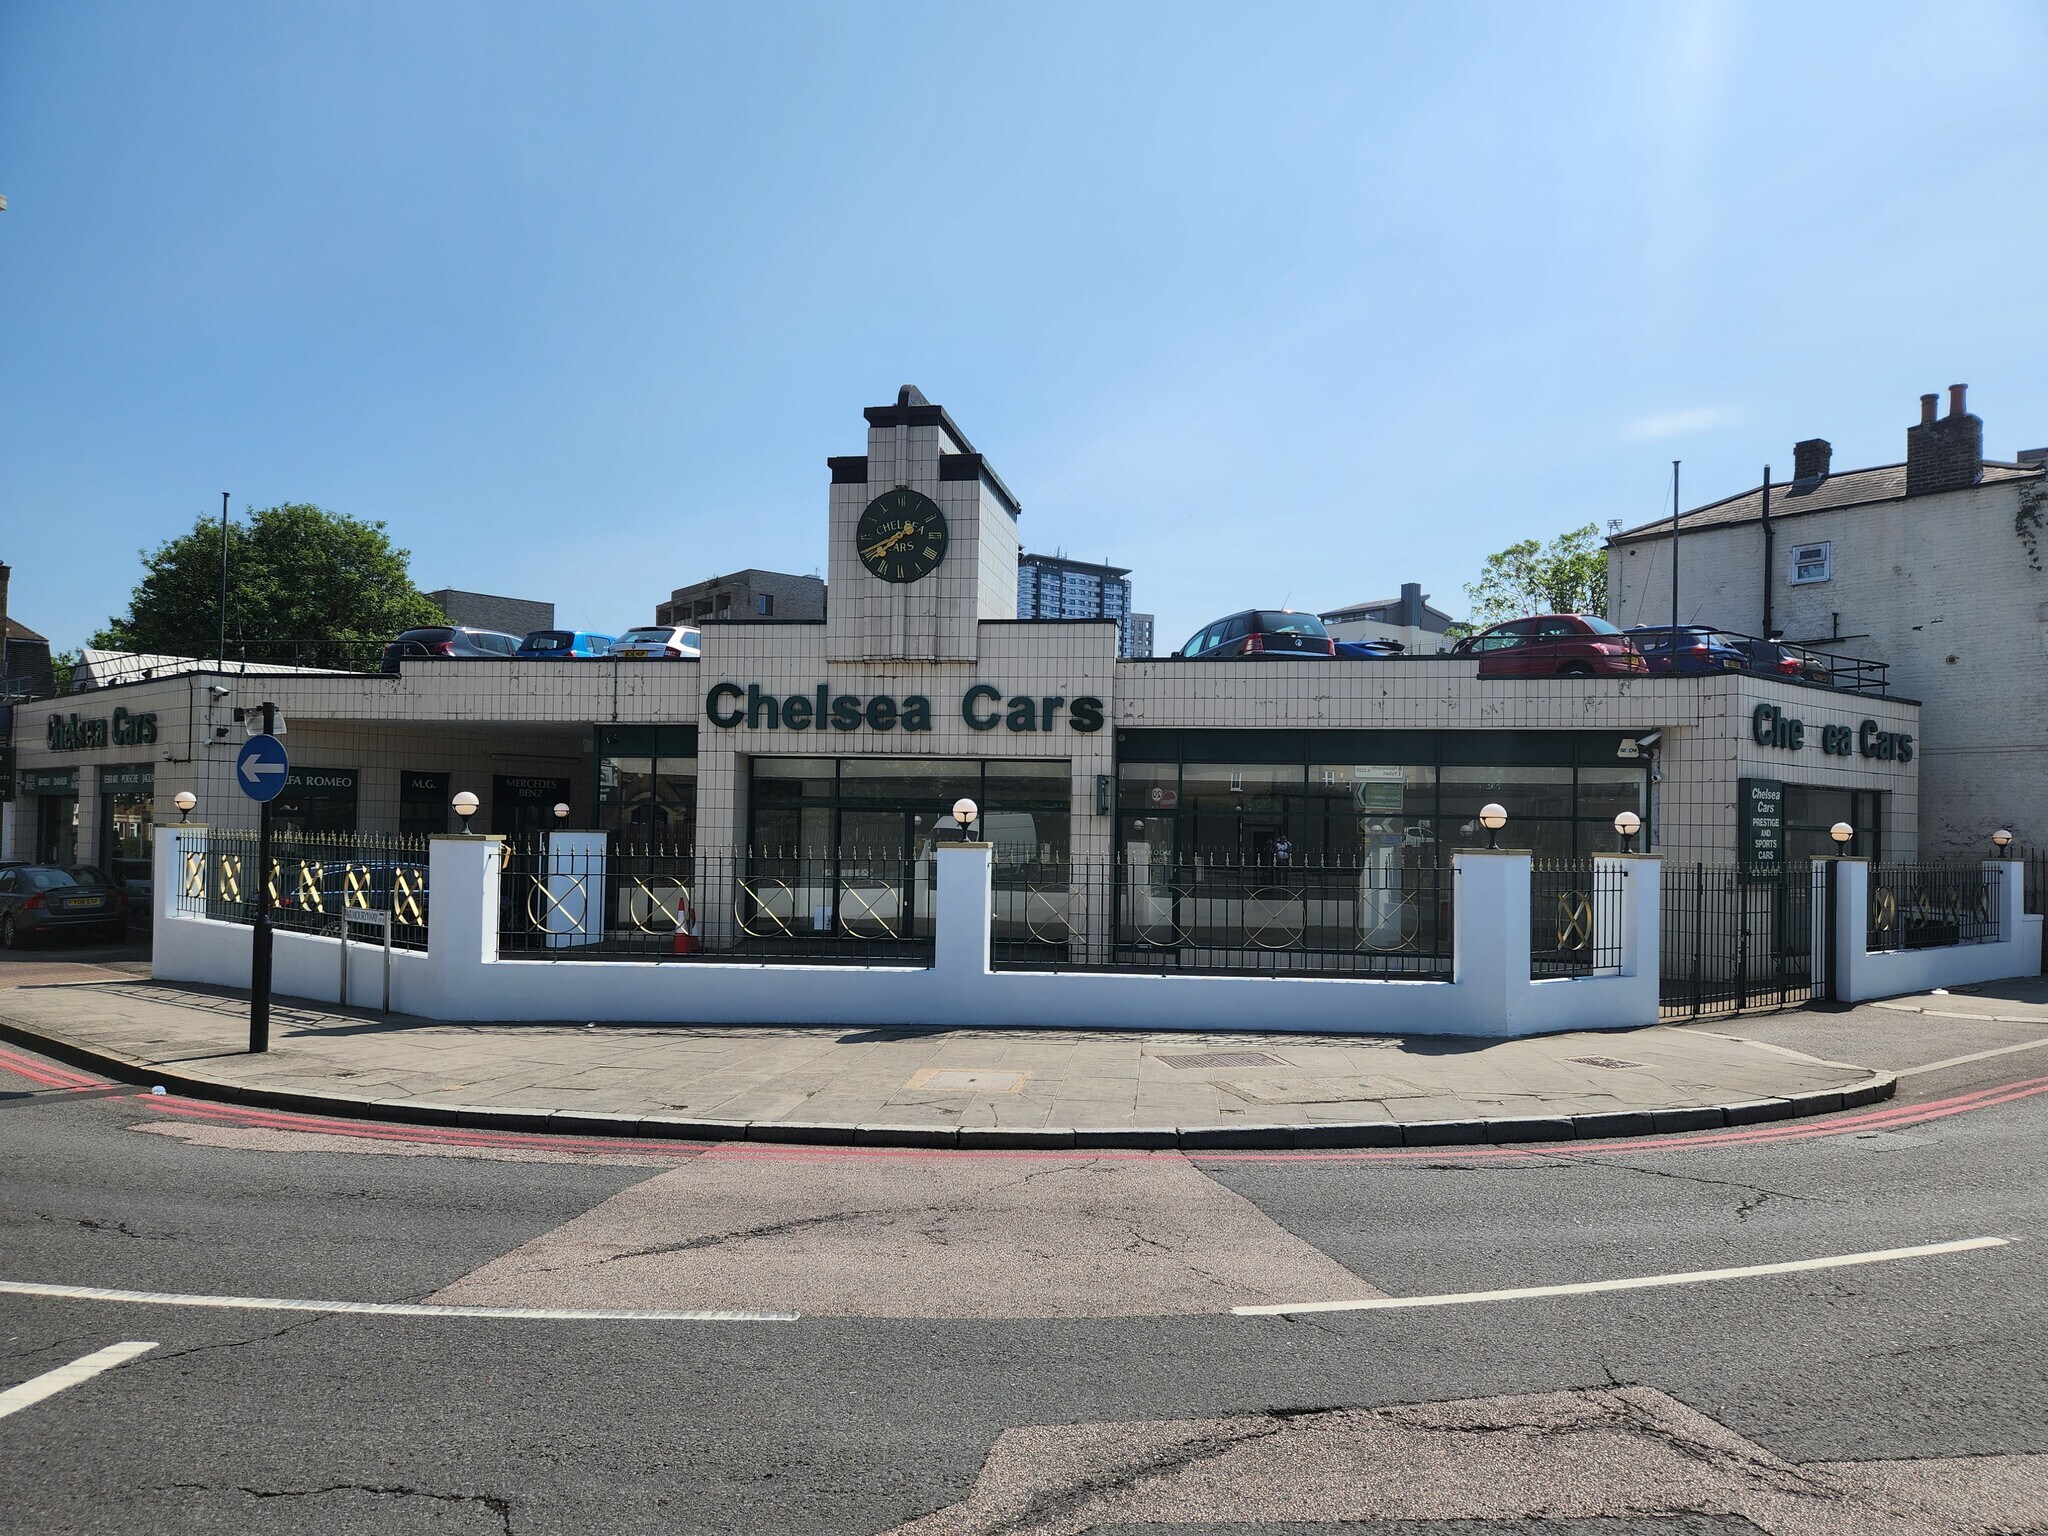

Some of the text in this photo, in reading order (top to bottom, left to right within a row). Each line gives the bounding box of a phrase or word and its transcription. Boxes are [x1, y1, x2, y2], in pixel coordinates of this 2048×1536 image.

[888, 541, 914, 552] ARS
[705, 682, 1104, 733] Chelsea Cars
[46, 707, 158, 750] Chelsea Cars
[1859, 719, 1913, 763] Cars
[306, 776, 352, 787] ROMEO
[412, 779, 436, 789] M.G.
[506, 778, 557, 789] MERCEDES
[518, 789, 543, 797] BENZ
[1752, 787, 1780, 800] Chelsea
[1757, 801, 1774, 813] Cars
[1752, 818, 1779, 827] PRESTIGE
[1760, 829, 1771, 837] AND
[1755, 839, 1777, 848] SPORTS
[1758, 851, 1774, 860] CARS
